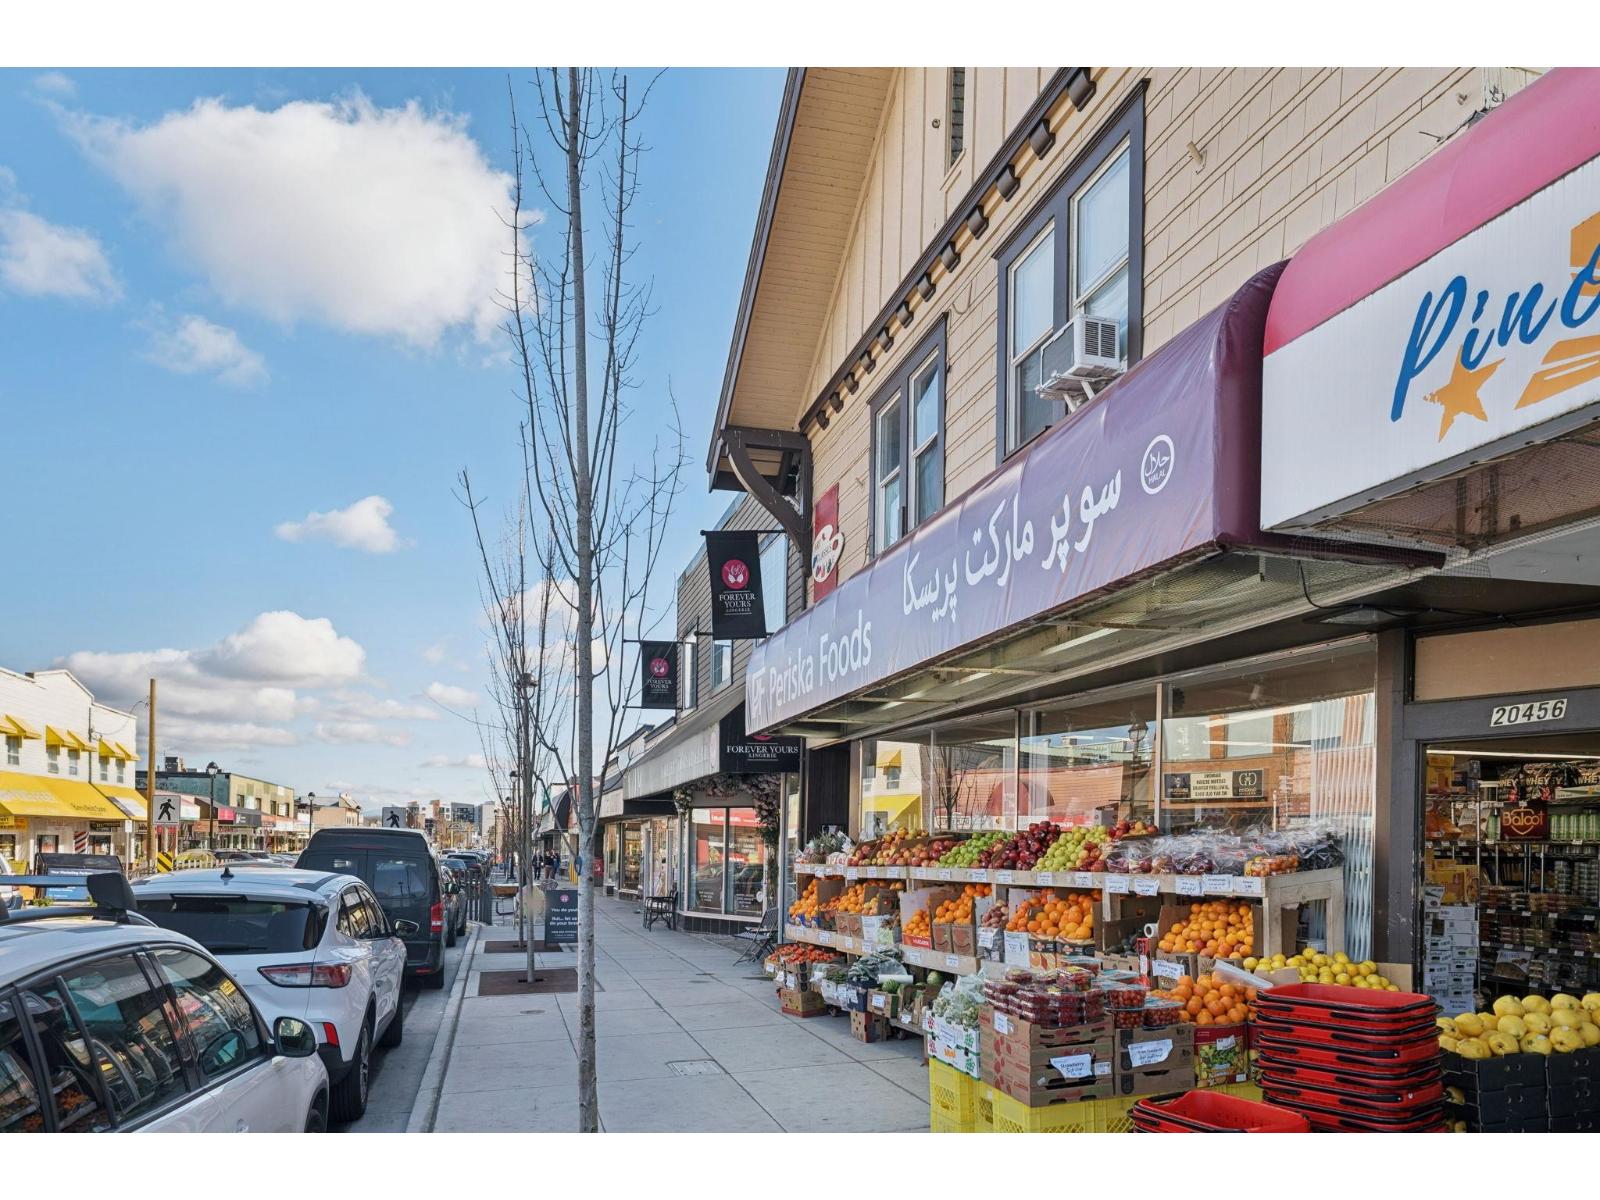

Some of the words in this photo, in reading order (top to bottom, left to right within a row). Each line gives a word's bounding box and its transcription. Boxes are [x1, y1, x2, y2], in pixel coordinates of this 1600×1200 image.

[1148, 469, 1166, 484] HALAL
[965, 492, 1034, 587] مارکت
[719, 593, 756, 601] FOREVER
[769, 648, 814, 711] Periska
[819, 609, 872, 687] Foods
[1493, 700, 1565, 725] 20456
[726, 745, 768, 753] FOREVER
[769, 745, 799, 753] YOURS
